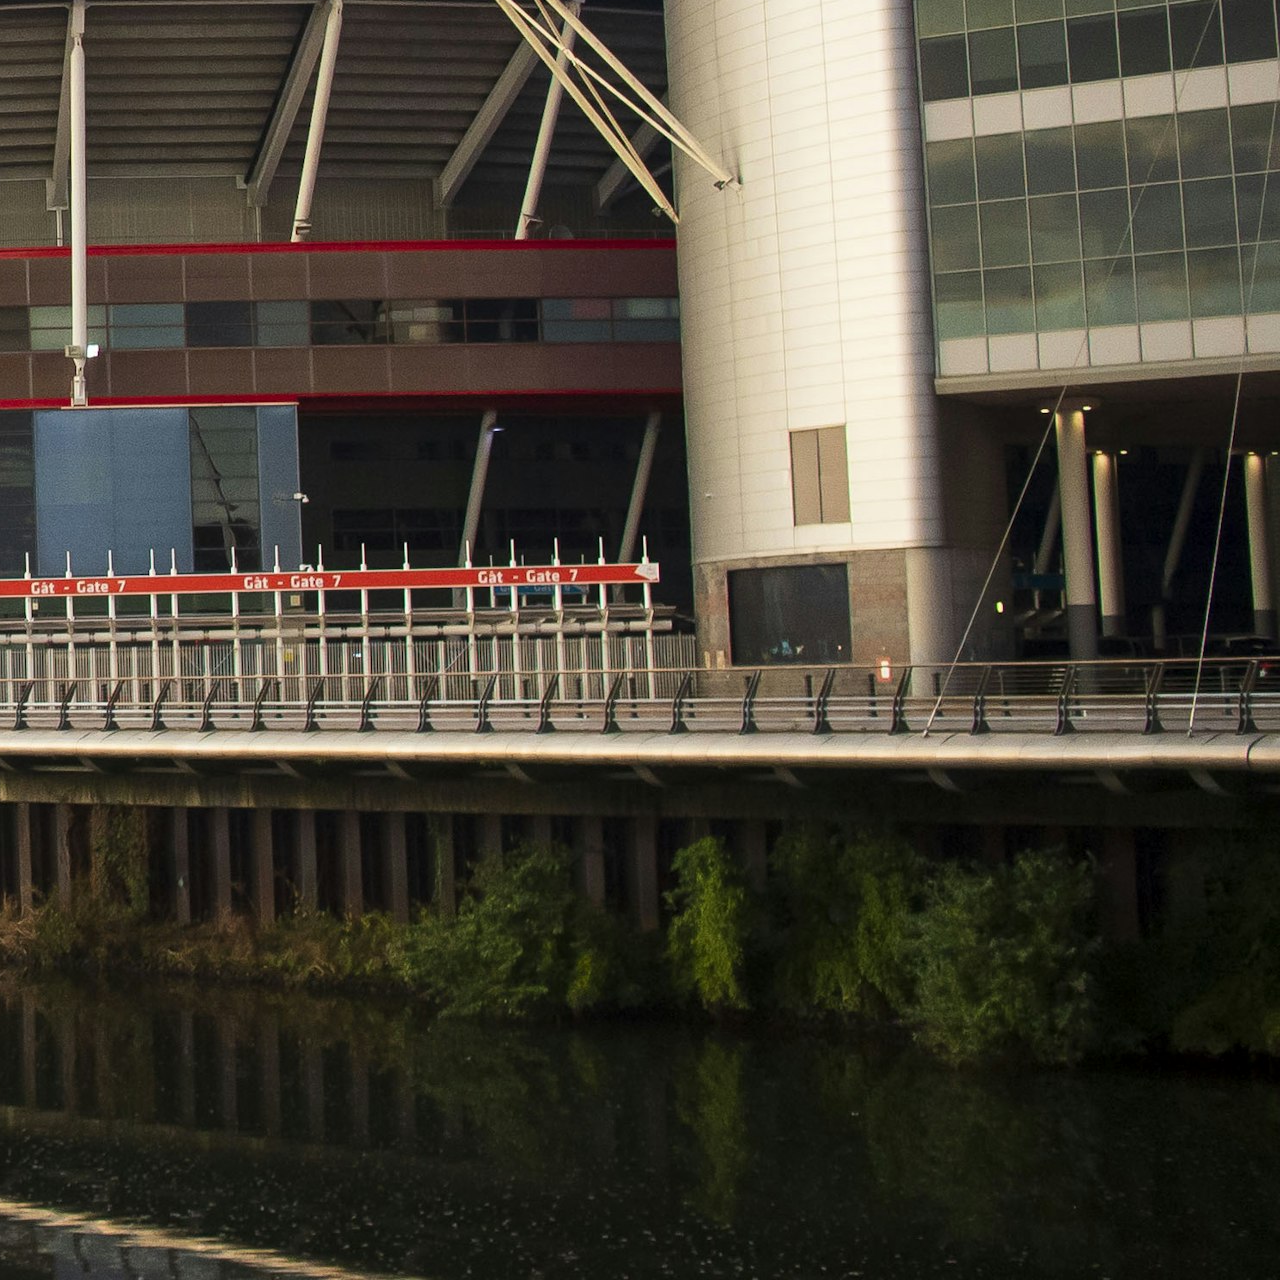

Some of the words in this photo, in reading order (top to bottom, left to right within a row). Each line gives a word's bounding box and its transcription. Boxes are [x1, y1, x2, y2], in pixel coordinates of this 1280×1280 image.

[290, 575, 324, 588] Gate
[332, 574, 341, 588] 7
[525, 569, 560, 583] Gate
[569, 568, 578, 582] 7
[76, 580, 109, 593] Gate
[117, 579, 126, 593] 7
